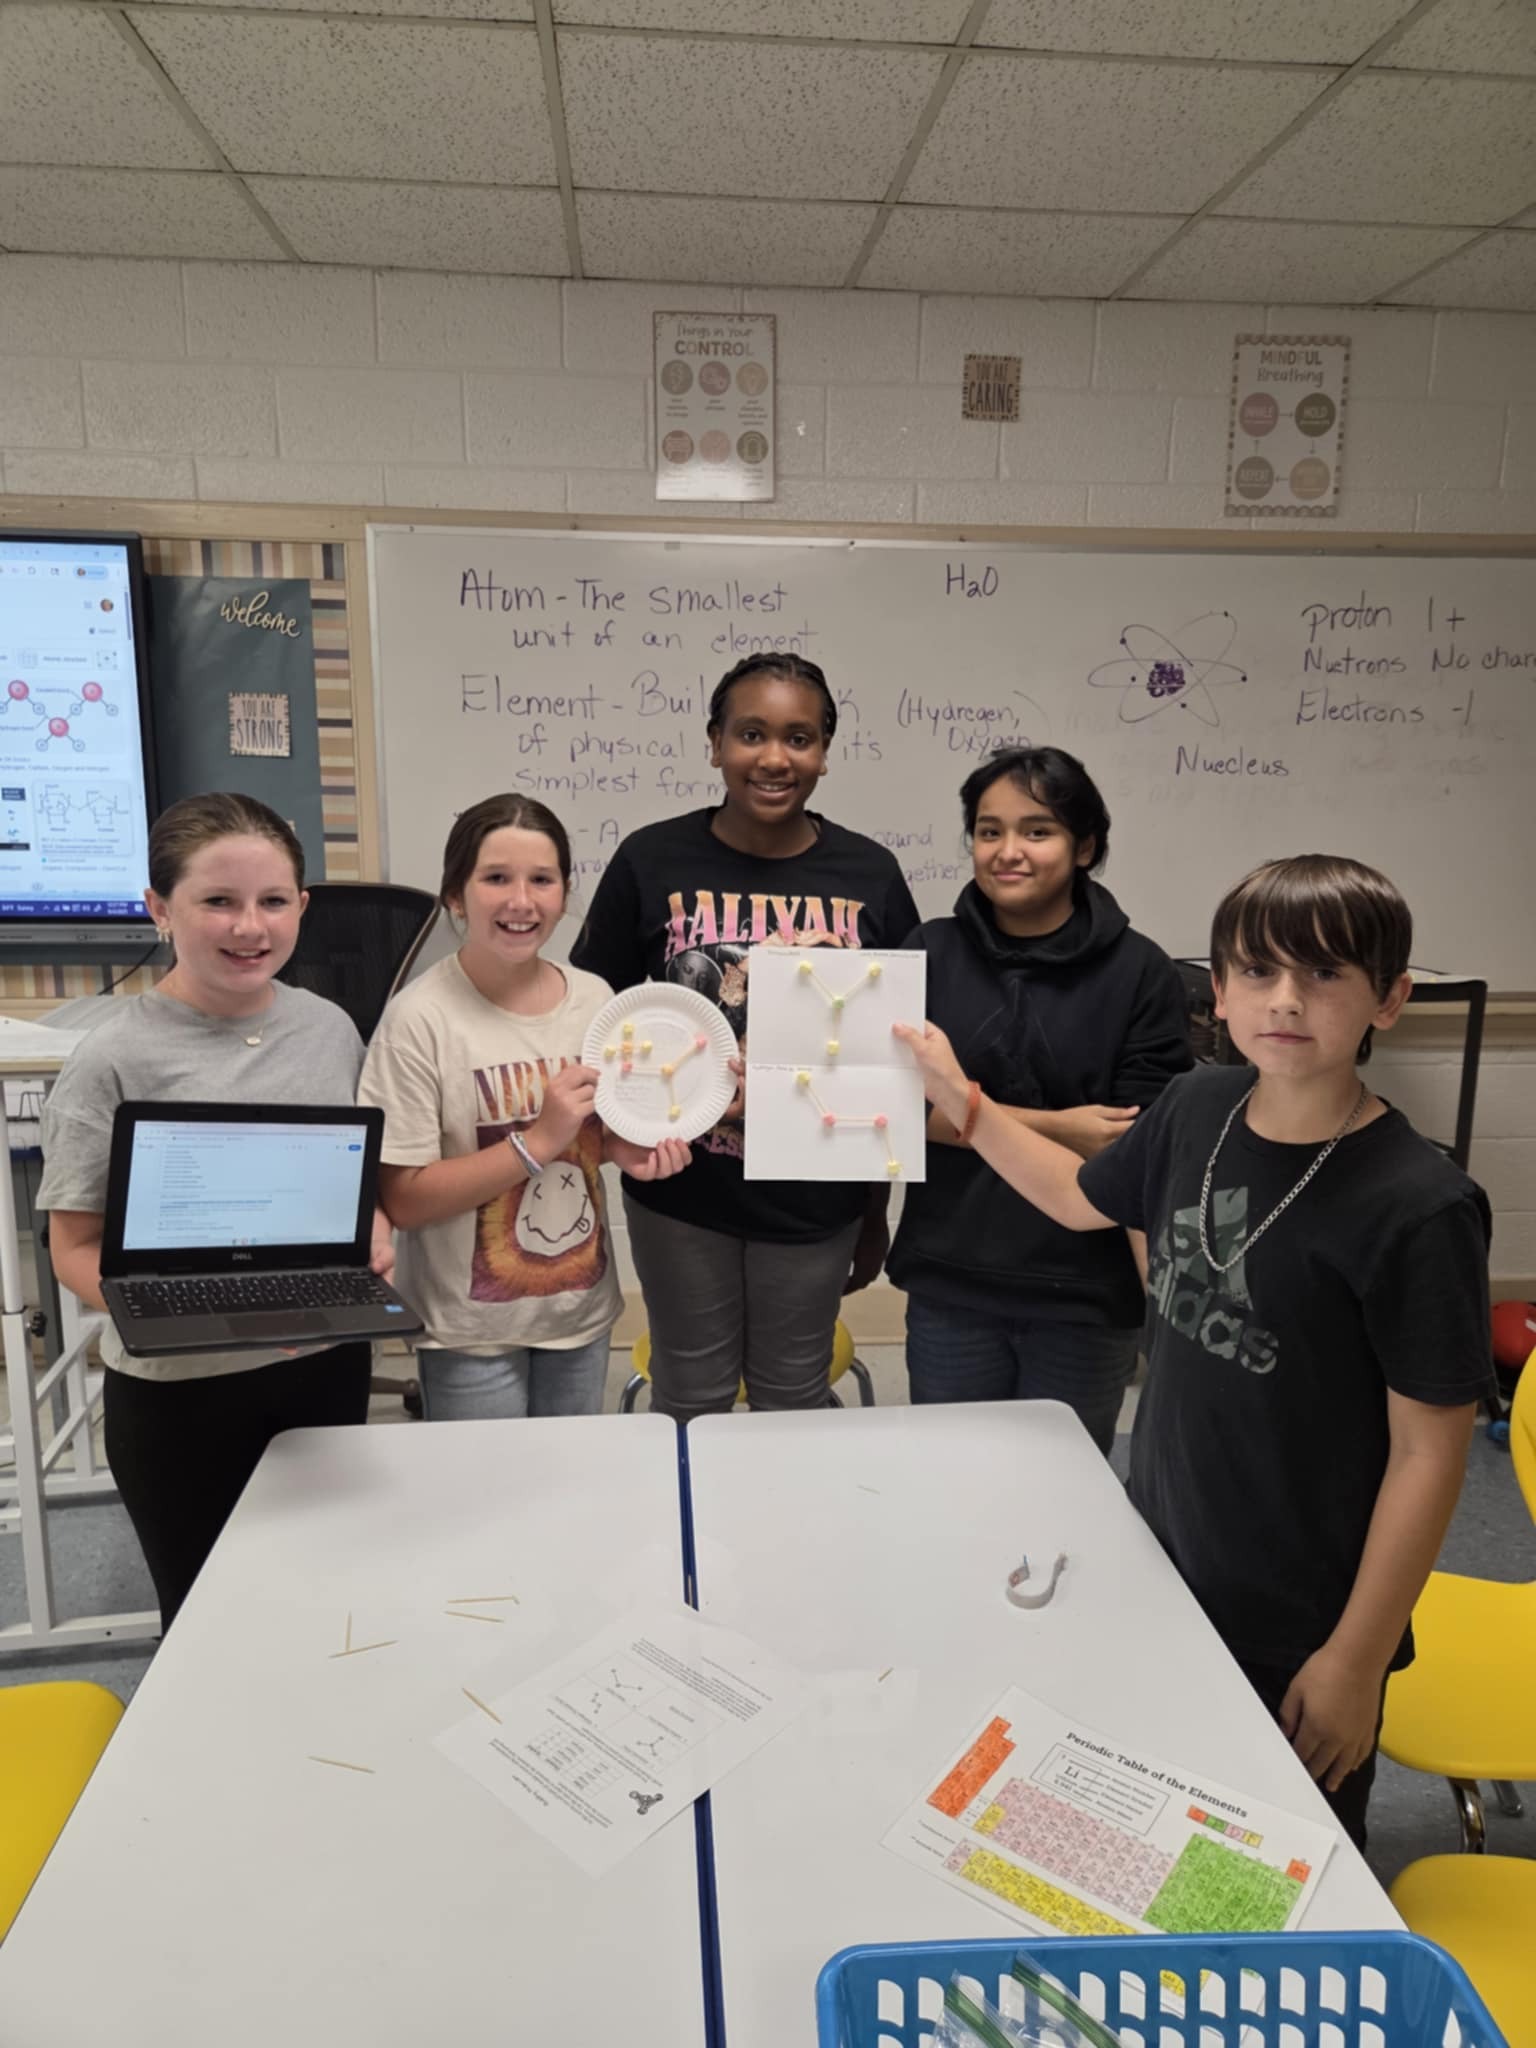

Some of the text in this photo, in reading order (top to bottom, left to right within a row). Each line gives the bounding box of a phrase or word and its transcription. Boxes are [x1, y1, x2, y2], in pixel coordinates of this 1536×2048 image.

[674, 339, 755, 357] CONTROL
[1260, 350, 1323, 366] MINDFUL
[1256, 367, 1325, 388] Breathing
[968, 381, 1014, 413] CARING
[575, 577, 627, 612] The
[220, 591, 301, 637] welcome
[513, 621, 575, 650] unit
[594, 619, 616, 648] of
[642, 630, 683, 650] an
[1432, 643, 1470, 672] No
[461, 673, 603, 721] Element
[1296, 687, 1425, 725] Electrons
[236, 718, 283, 750] STRONG
[519, 722, 547, 755] of
[570, 730, 686, 763] physical
[1064, 1765, 1080, 1779] Li
[1066, 1731, 1249, 1819] Periodic Table of the Elements
